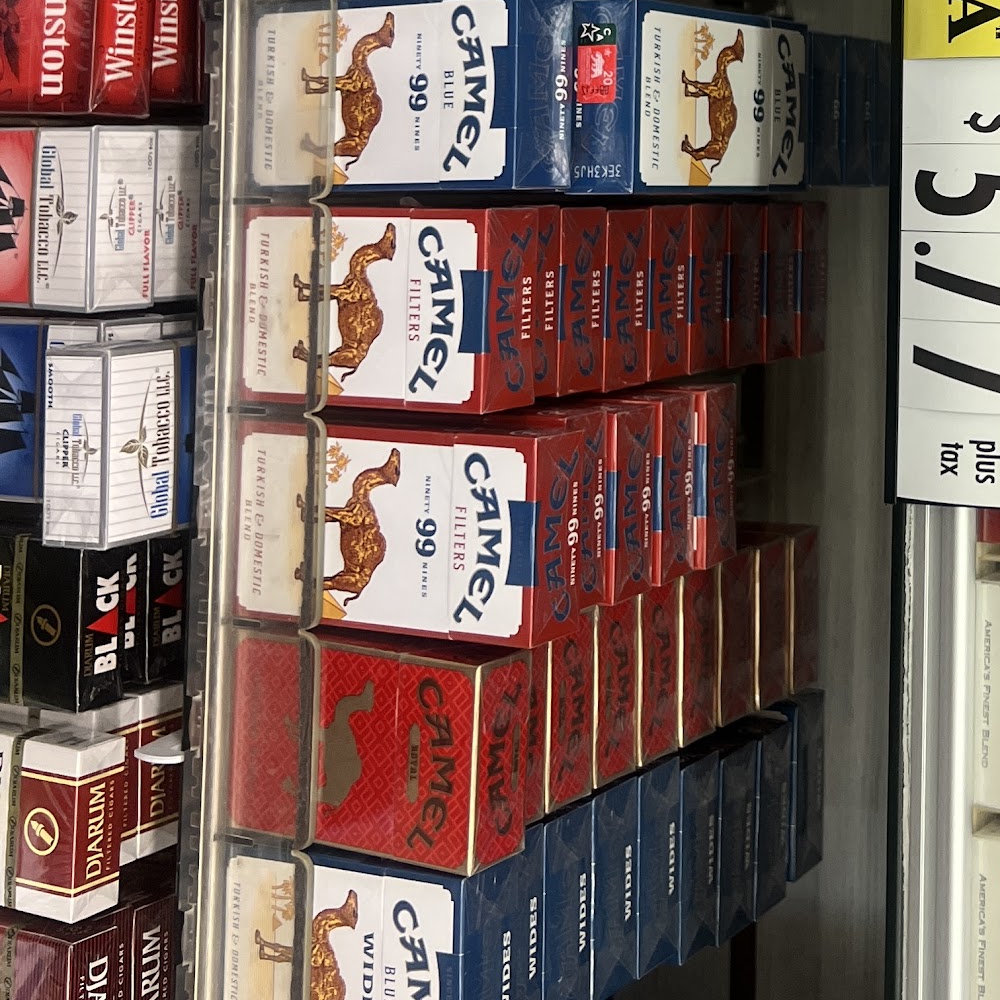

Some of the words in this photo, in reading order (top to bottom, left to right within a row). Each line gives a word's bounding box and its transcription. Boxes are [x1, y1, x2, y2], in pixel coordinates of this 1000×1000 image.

[408, 73, 428, 112] 99
[442, 5, 487, 173] CAMEL
[443, 70, 454, 110] BLUE
[39, 145, 57, 189] Global
[37, 195, 54, 256] Tobacco
[408, 226, 455, 394] CAMEL
[408, 279, 422, 342] FILTERS
[521, 277, 533, 340] FILTERS
[544, 270, 555, 331] FILTERS
[61, 429, 69, 468] CLIPPER
[151, 402, 170, 467] Tobacco
[940, 443, 964, 477] tax
[150, 472, 170, 519] Global
[415, 518, 437, 558] 99
[453, 452, 502, 623] CAMEL
[453, 507, 467, 571] FILTERS
[983, 620, 992, 681] AMERICA'S
[982, 684, 991, 727] FINEST
[406, 677, 455, 848] CAMEL
[409, 744, 418, 781] ROYAL
[981, 729, 990, 768] BLEND
[85, 782, 106, 880] DJARUM
[578, 873, 587, 953] WIDES
[624, 845, 632, 921] WIDES
[528, 897, 538, 980] WIDES
